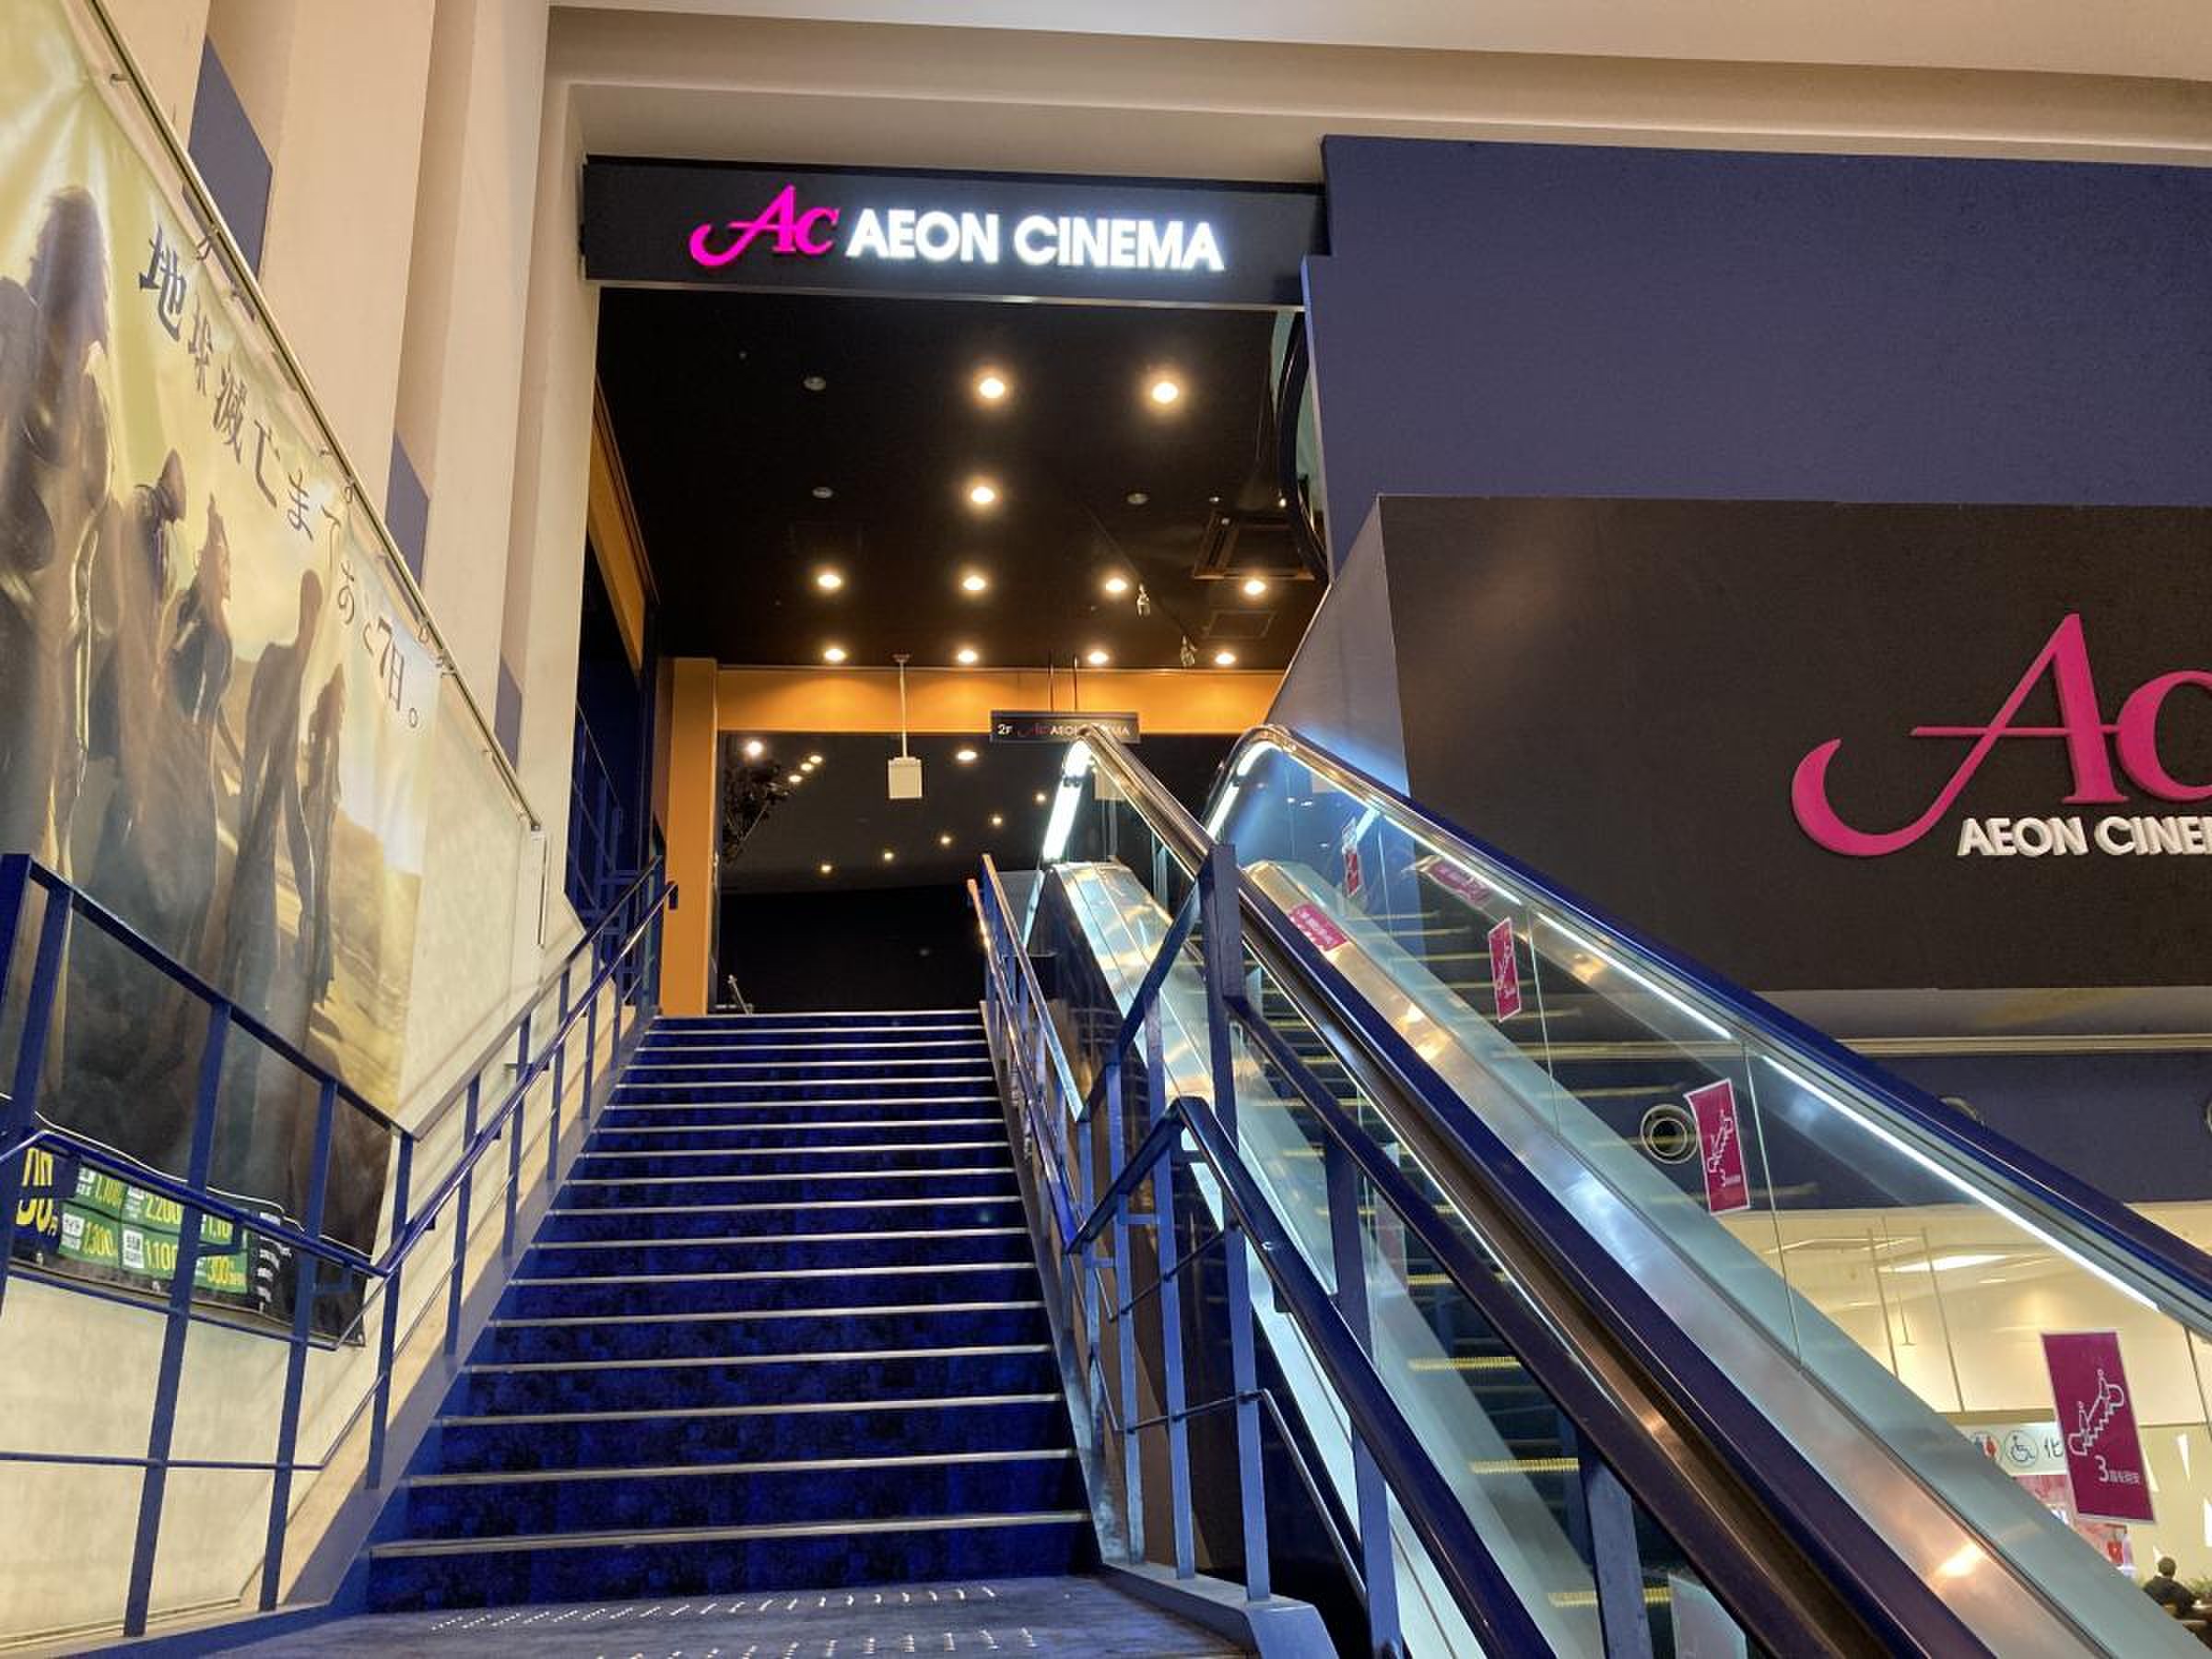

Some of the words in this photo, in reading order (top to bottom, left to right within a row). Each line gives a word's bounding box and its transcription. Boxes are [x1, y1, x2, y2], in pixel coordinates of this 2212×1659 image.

[844, 206, 1002, 264] AEON
[1014, 213, 1225, 272] CINEMA
[1957, 817, 2089, 856] AEON
[2094, 816, 2212, 856] CINE
